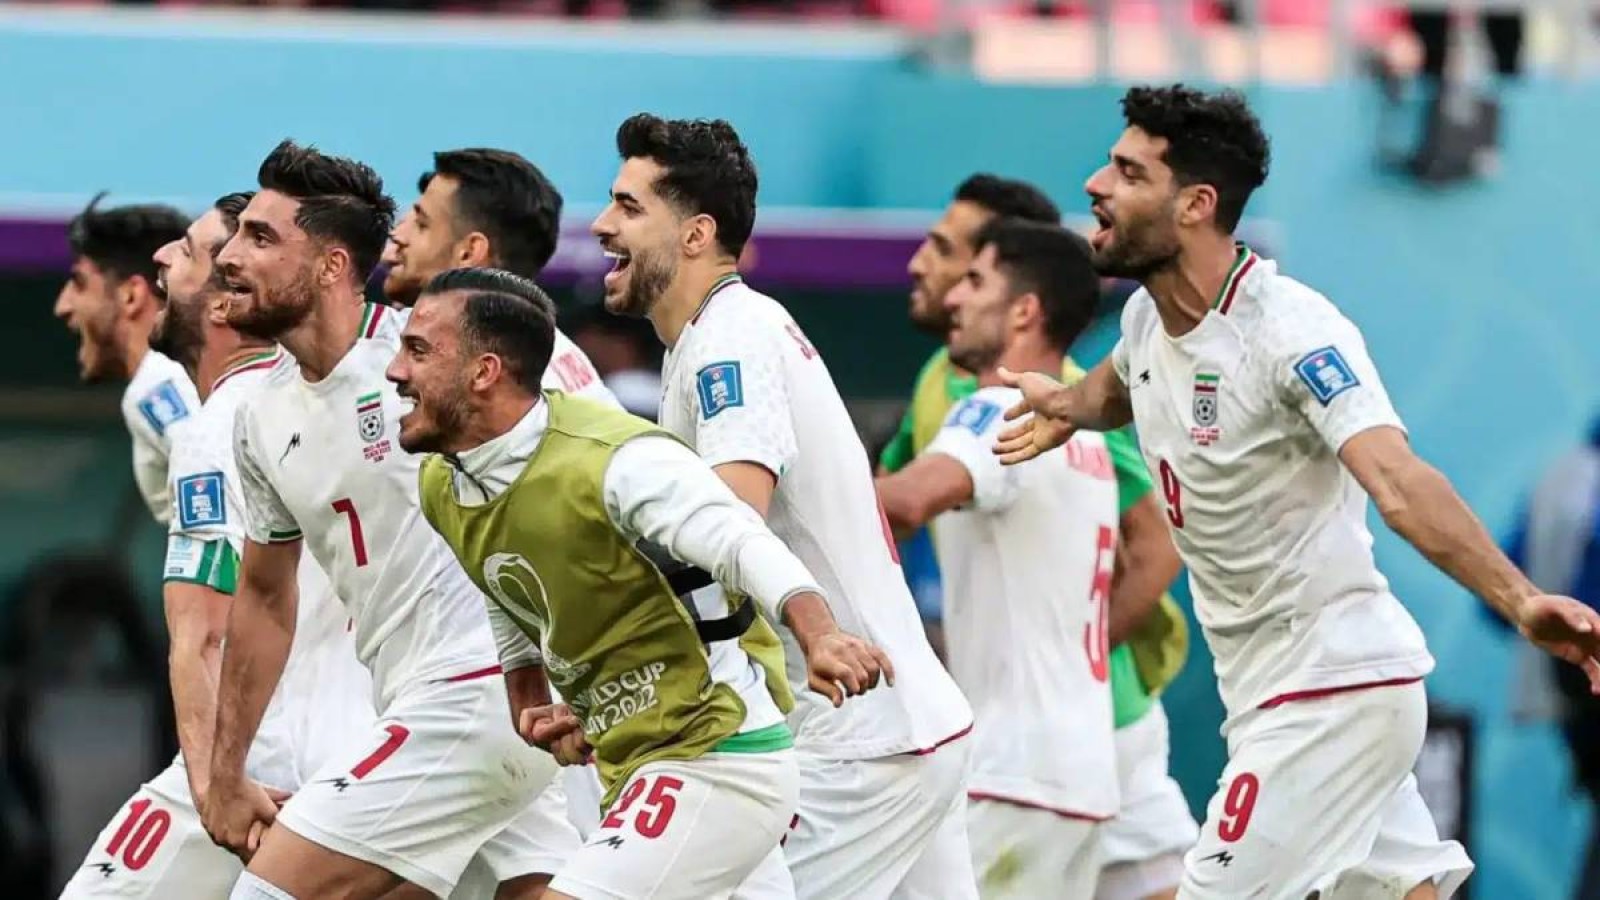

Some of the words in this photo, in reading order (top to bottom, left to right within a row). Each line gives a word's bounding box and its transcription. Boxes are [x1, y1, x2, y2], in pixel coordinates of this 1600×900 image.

[1159, 459, 1184, 529] 9
[332, 498, 368, 567] 7
[603, 683, 658, 726] 2022
[620, 661, 667, 691] CUP
[350, 724, 410, 780] 7
[106, 798, 171, 871] 10
[601, 775, 684, 839] 25
[1217, 772, 1259, 843] 9
